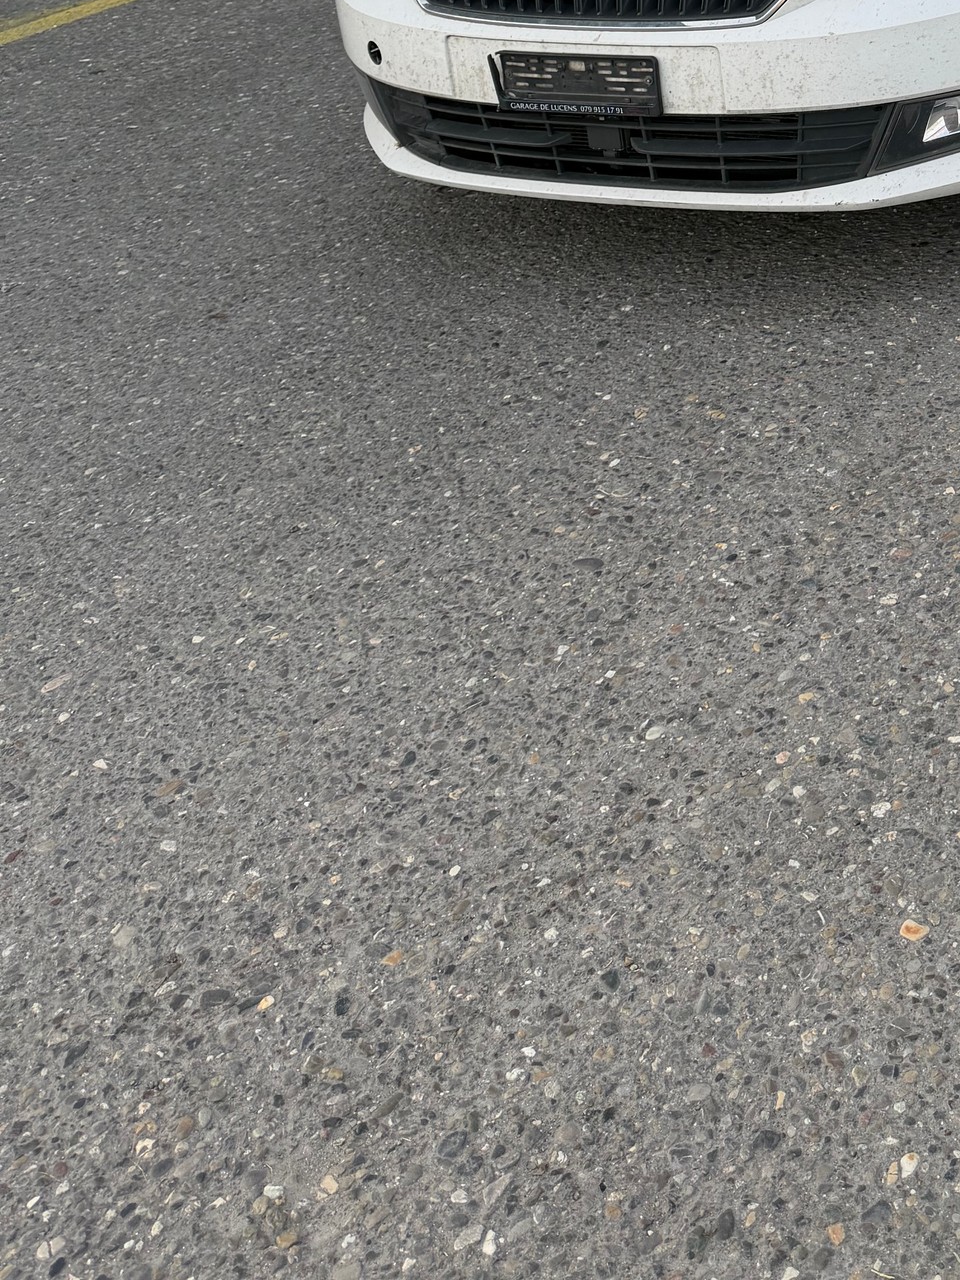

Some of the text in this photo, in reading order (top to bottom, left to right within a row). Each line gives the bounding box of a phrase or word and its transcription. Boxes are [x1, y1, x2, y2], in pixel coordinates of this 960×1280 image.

[510, 102, 539, 110] GARAGE
[550, 104, 578, 112] LUCENS
[580, 105, 592, 113] 079
